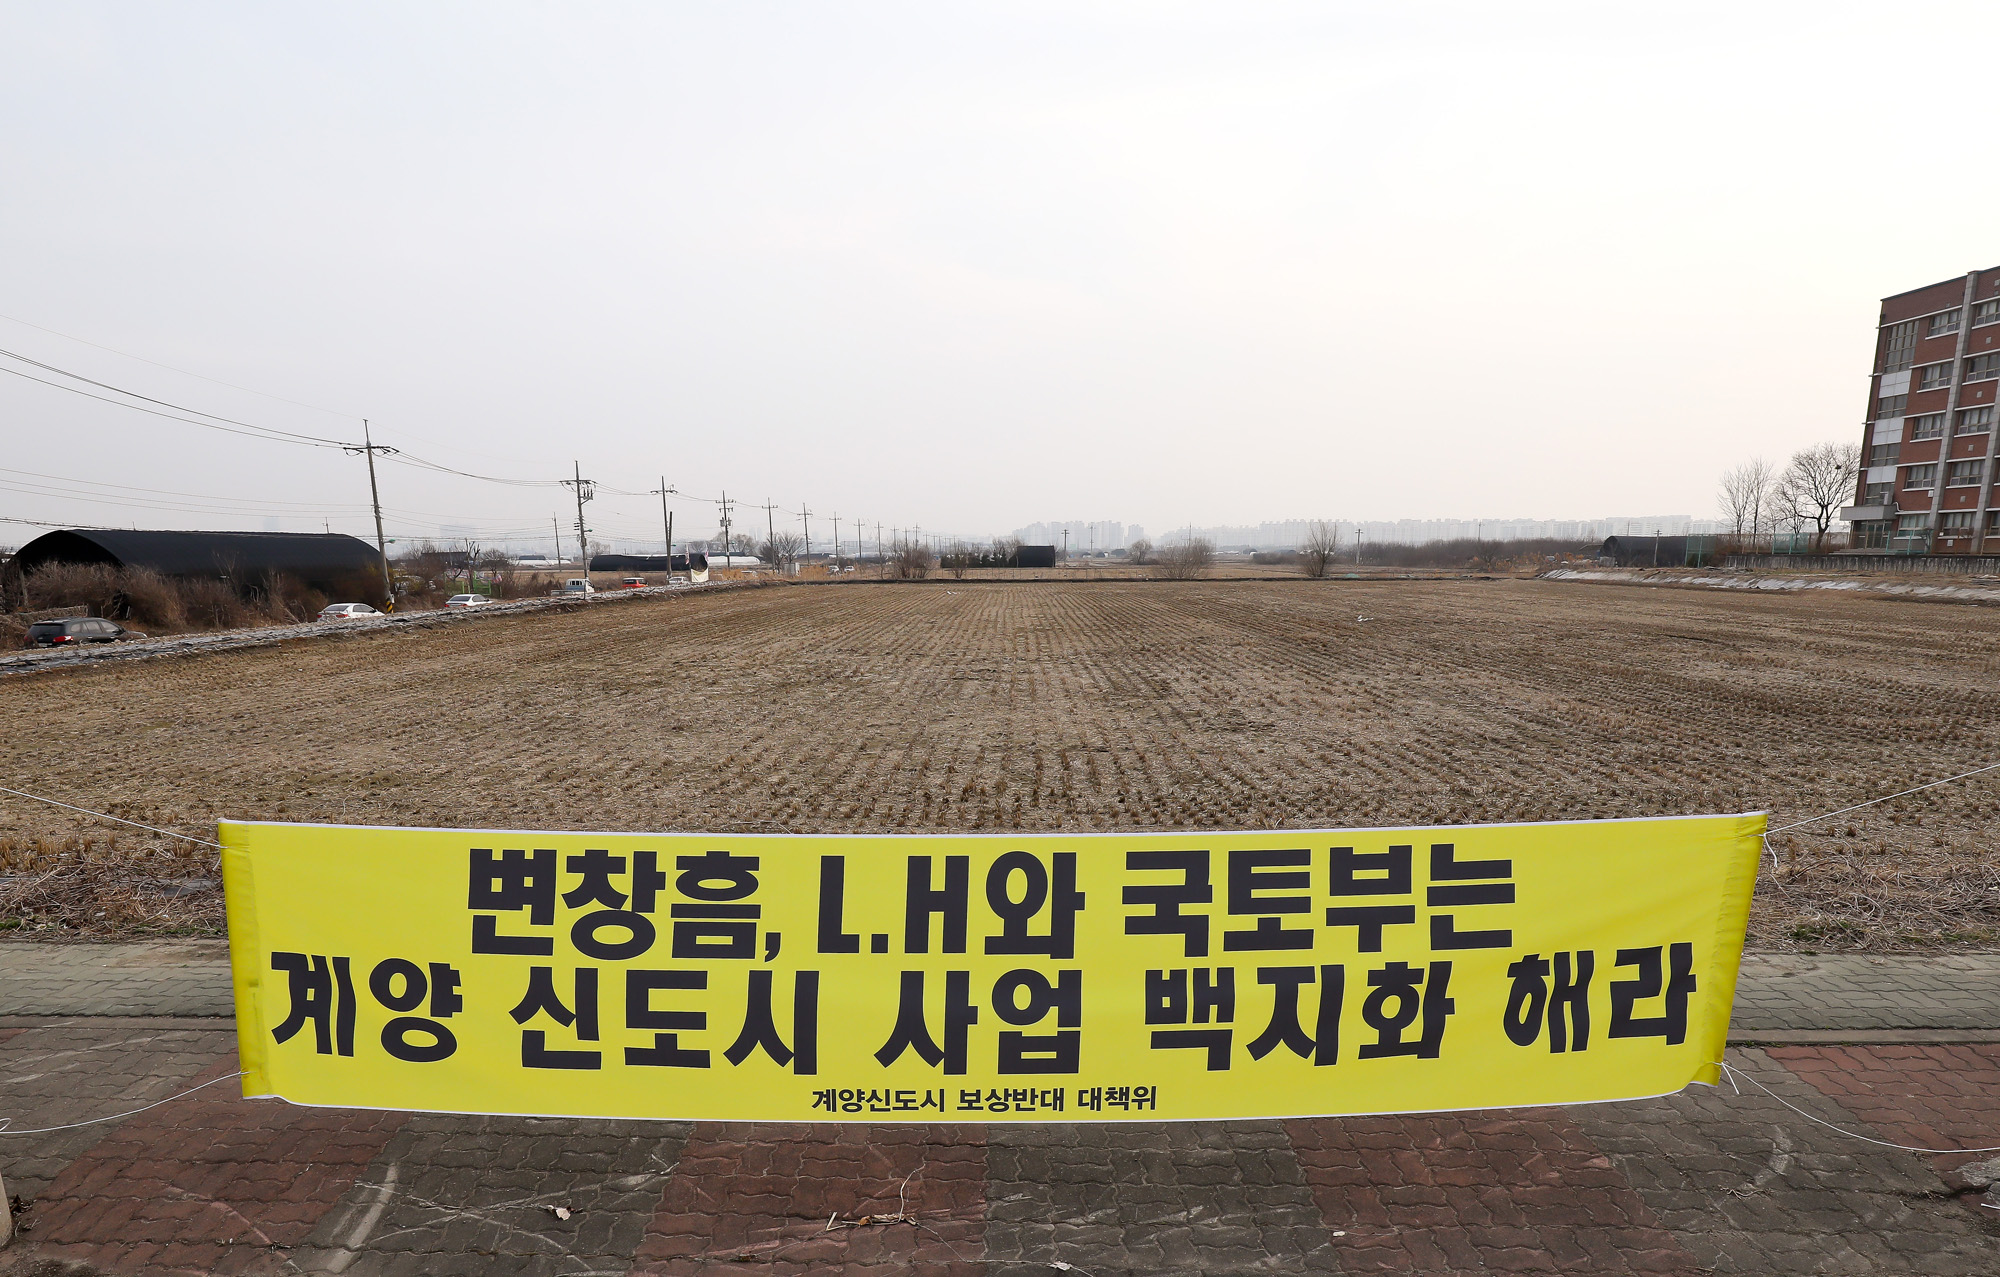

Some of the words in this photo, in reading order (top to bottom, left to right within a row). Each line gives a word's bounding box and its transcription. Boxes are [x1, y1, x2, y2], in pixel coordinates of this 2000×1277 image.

[468, 849, 781, 962] 변창흠,
[818, 851, 1085, 959] L.H와
[1122, 844, 1515, 957] 국토부는
[271, 952, 462, 1062] 계양
[509, 967, 819, 1075] 신도시
[874, 969, 1082, 1078] 사업
[1145, 961, 1455, 1071] 백지화
[1503, 942, 1696, 1053] 해라
[812, 1088, 945, 1112] 계양신도시
[957, 1088, 1064, 1112] 보상반대
[1078, 1086, 1156, 1111] 대책위
